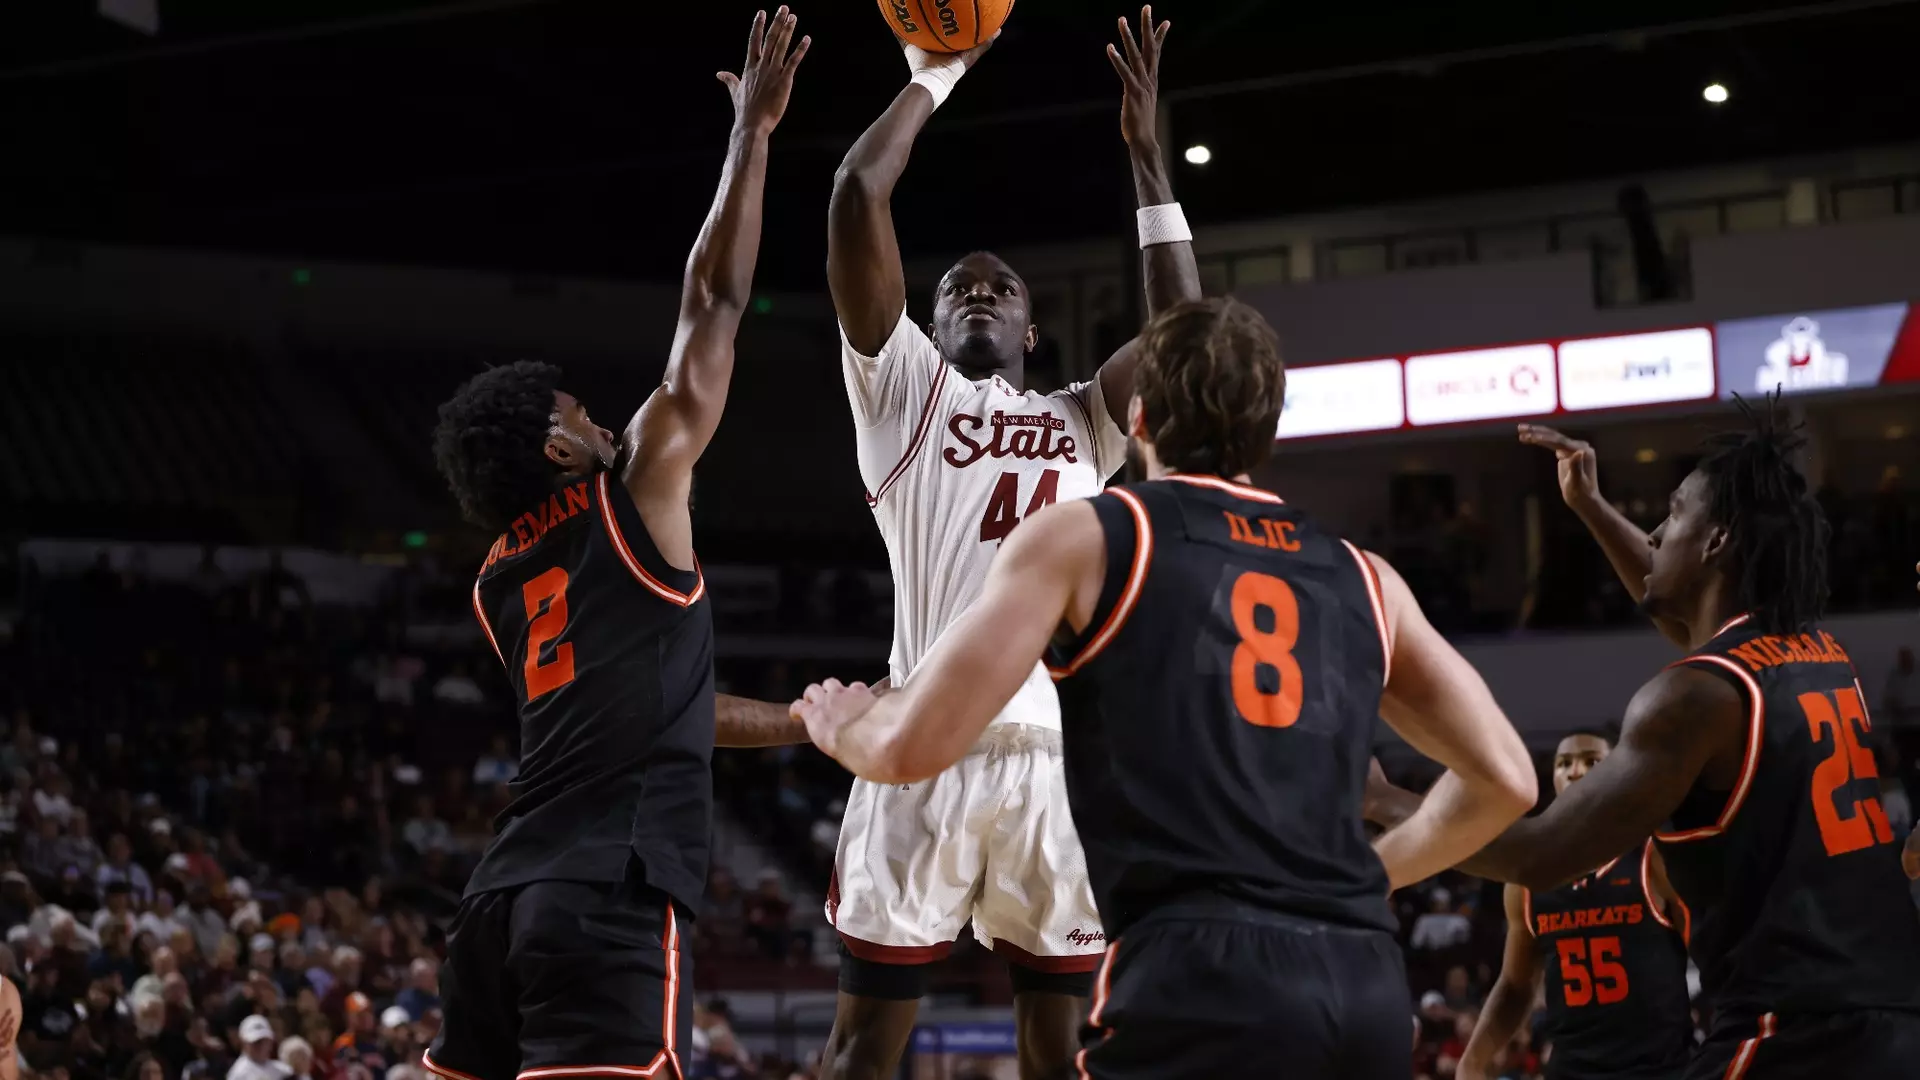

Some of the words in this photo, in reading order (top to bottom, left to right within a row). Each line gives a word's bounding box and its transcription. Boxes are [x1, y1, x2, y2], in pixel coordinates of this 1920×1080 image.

[943, 410, 1077, 468] State
[993, 416, 1018, 425] NEW
[1023, 417, 1063, 429] MEXICO
[479, 481, 591, 575] OLEMAN
[1222, 510, 1302, 552] ILIC
[522, 566, 576, 703] 2
[1230, 571, 1304, 728] 8
[1797, 686, 1895, 857] 25
[1537, 903, 1644, 936] BEARKATS
[1556, 935, 1630, 1008] 55
